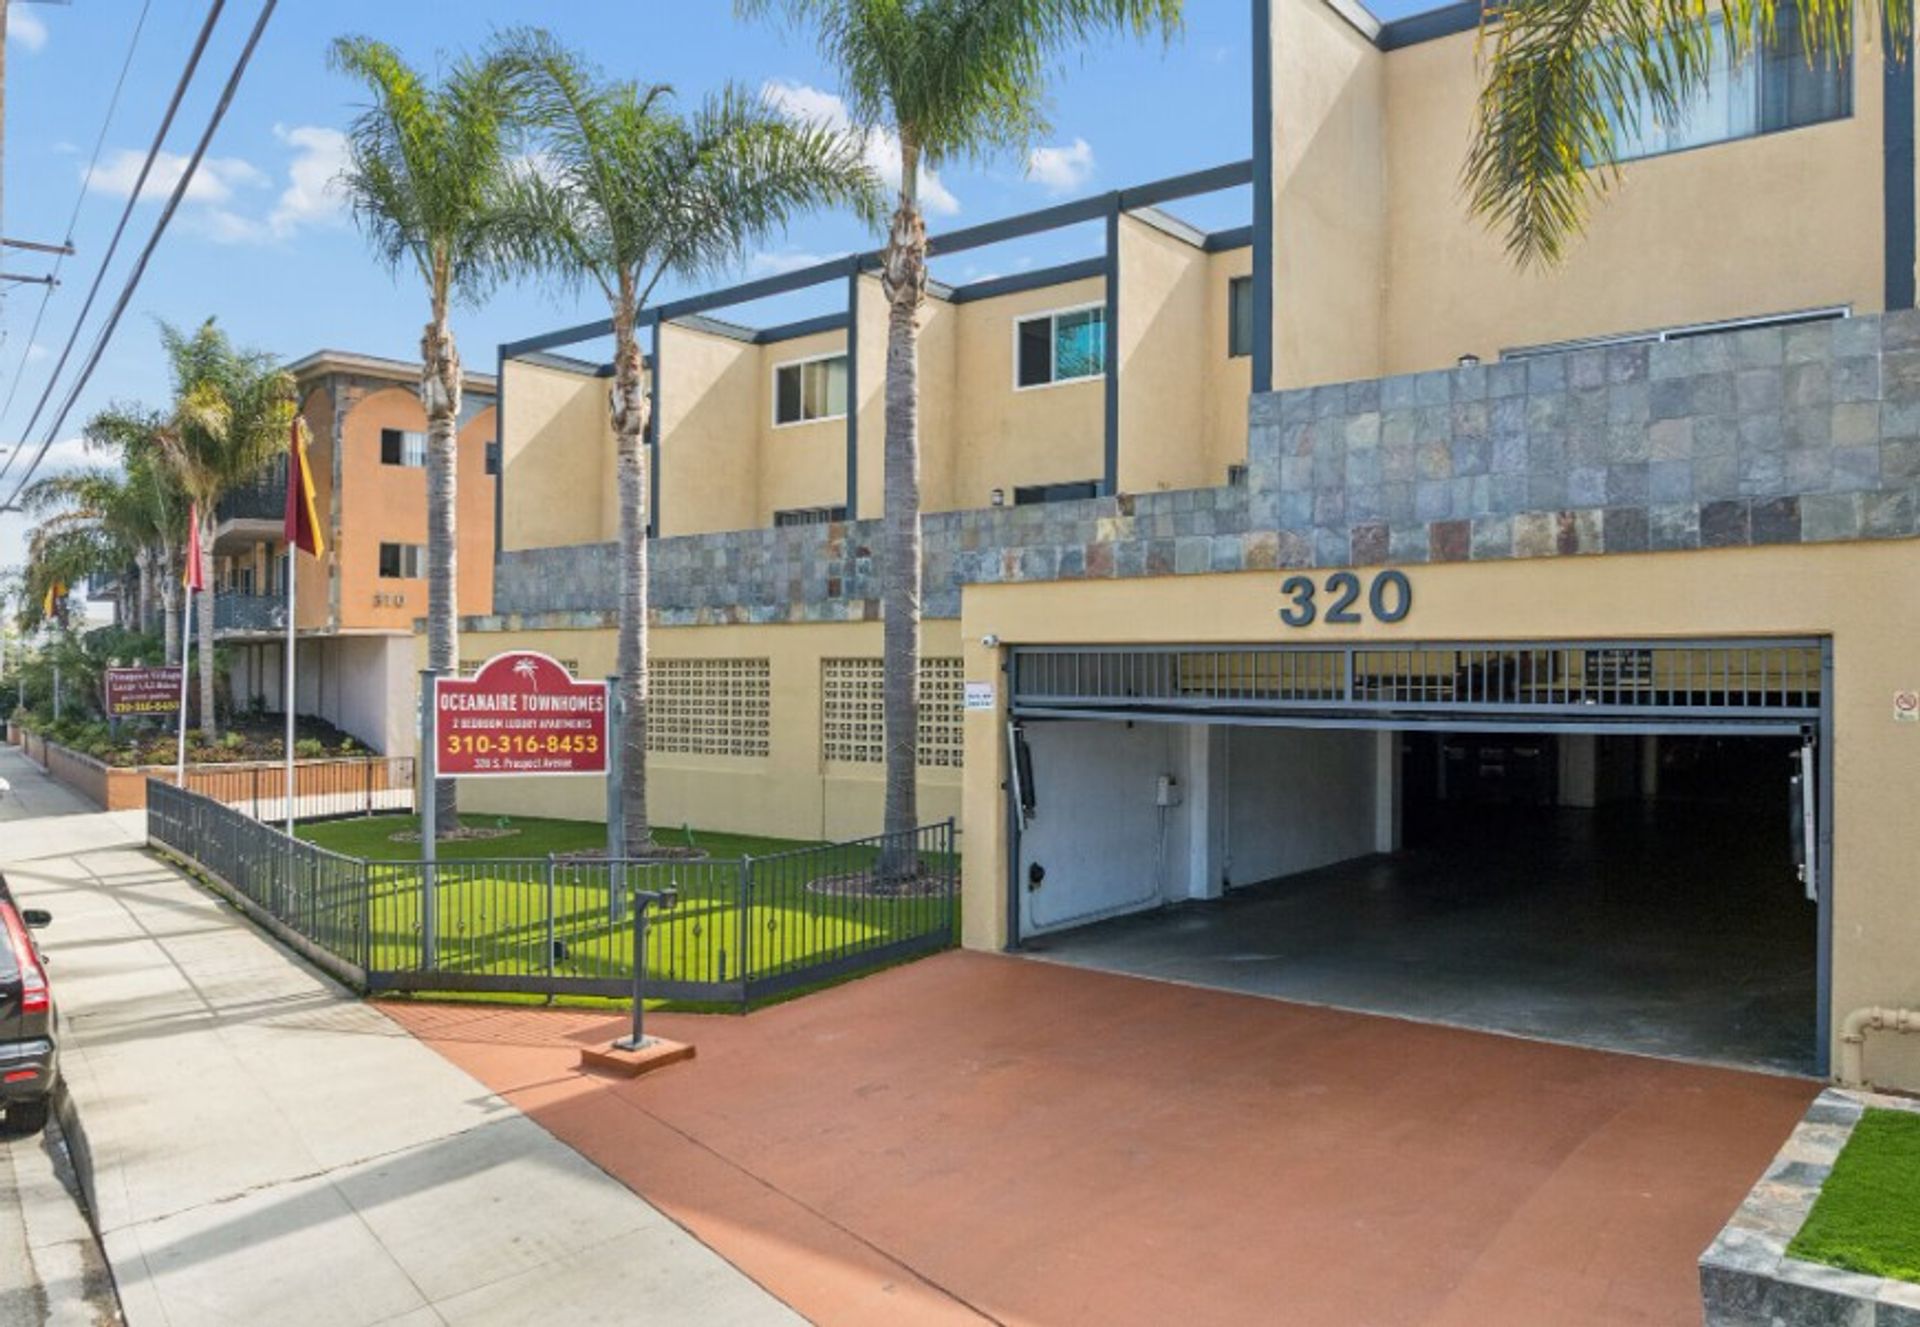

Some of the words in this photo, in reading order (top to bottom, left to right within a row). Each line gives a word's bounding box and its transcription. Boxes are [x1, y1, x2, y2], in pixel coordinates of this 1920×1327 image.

[1280, 570, 1412, 627] 320
[440, 694, 517, 711] OCEANAIRE
[522, 694, 604, 712] TOWNHOMES
[453, 718, 458, 729] 2
[460, 718, 503, 729] BEDROOM
[505, 718, 537, 729] LUXURY
[539, 718, 592, 729] APARTMENTS
[447, 735, 599, 754] 310-316-8453
